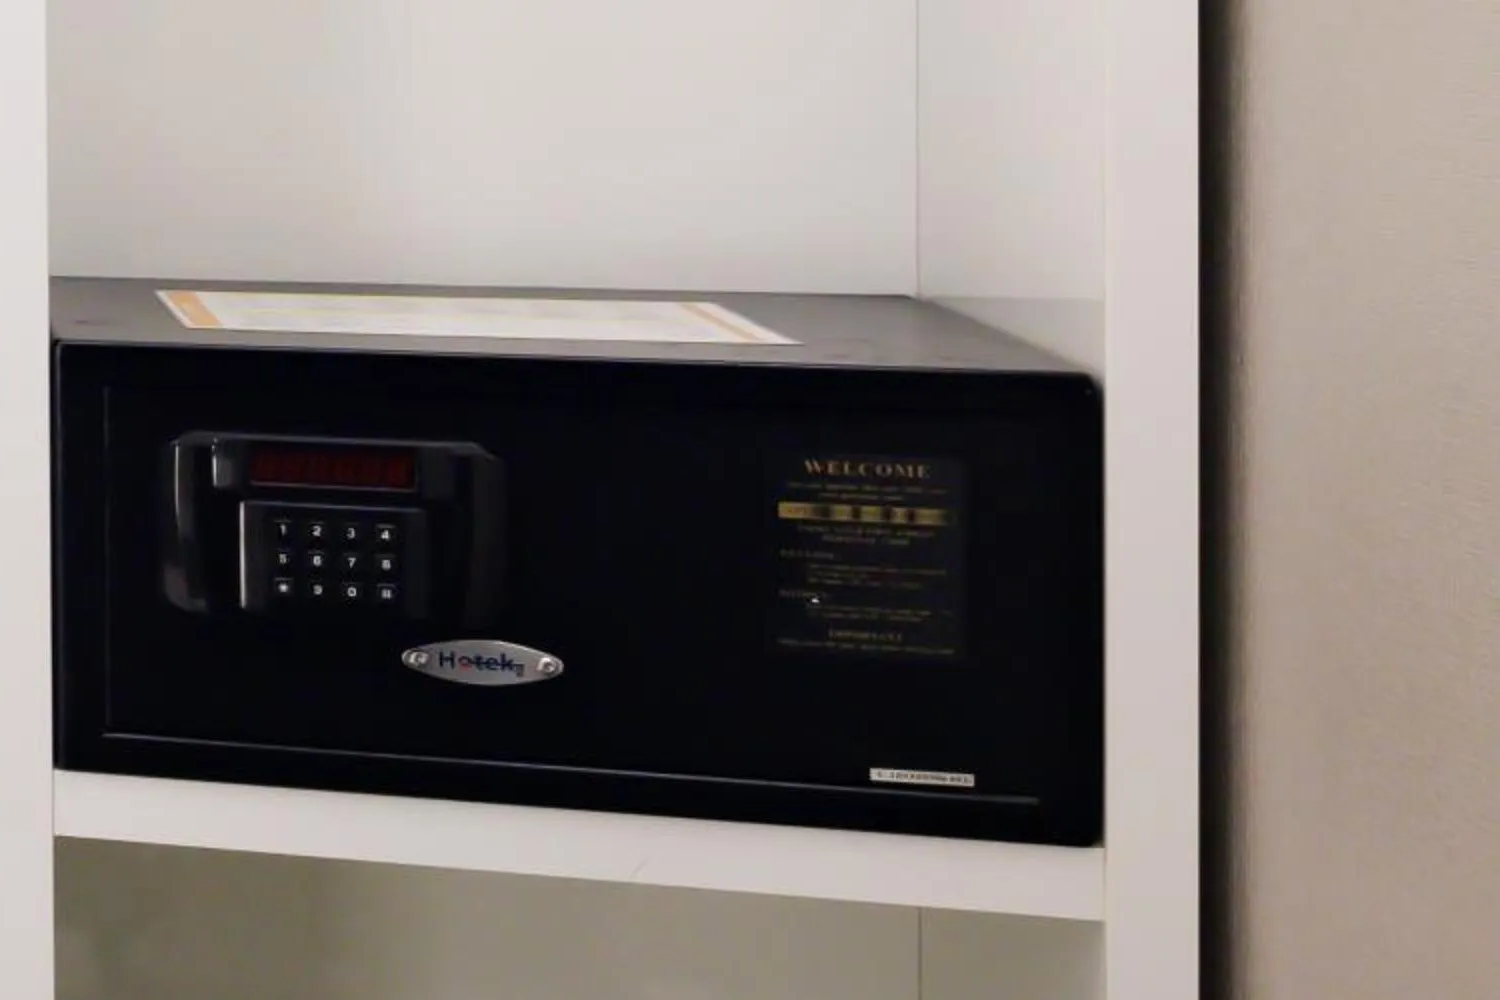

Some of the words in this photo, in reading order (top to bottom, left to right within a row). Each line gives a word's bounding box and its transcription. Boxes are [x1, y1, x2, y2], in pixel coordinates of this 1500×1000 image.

[804, 459, 930, 479] WELCOME
[312, 524, 322, 538] 2
[347, 526, 356, 540] 3
[380, 528, 391, 541] 4
[312, 554, 322, 568] 6
[347, 556, 357, 569] 7
[438, 651, 515, 672] Hotek
